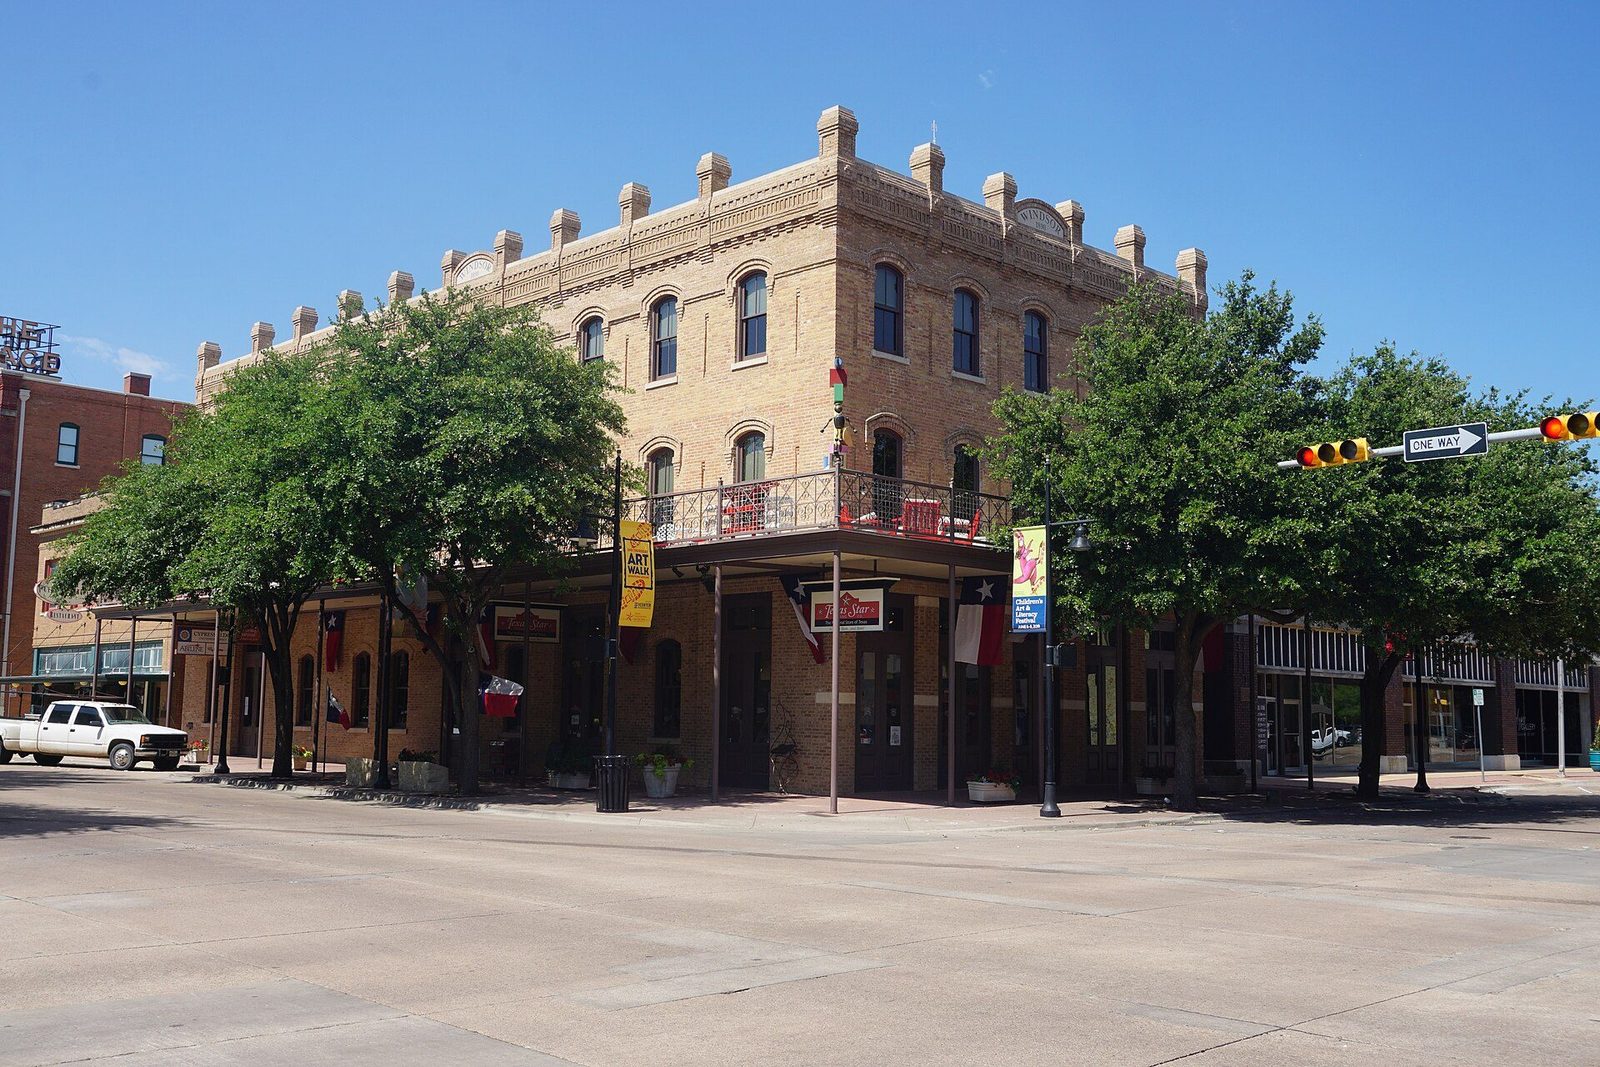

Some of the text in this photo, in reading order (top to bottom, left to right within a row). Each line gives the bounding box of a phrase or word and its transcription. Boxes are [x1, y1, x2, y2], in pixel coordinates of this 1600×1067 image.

[1020, 209, 1062, 235] WINDSOR
[459, 261, 492, 280] WINDSOR
[1413, 436, 1460, 451] ONE WAY
[627, 553, 649, 567] ART
[627, 565, 650, 576] WALK
[825, 602, 870, 619] Teas Star
[1015, 611, 1038, 620] Literacy
[507, 618, 547, 631] Texa Star
